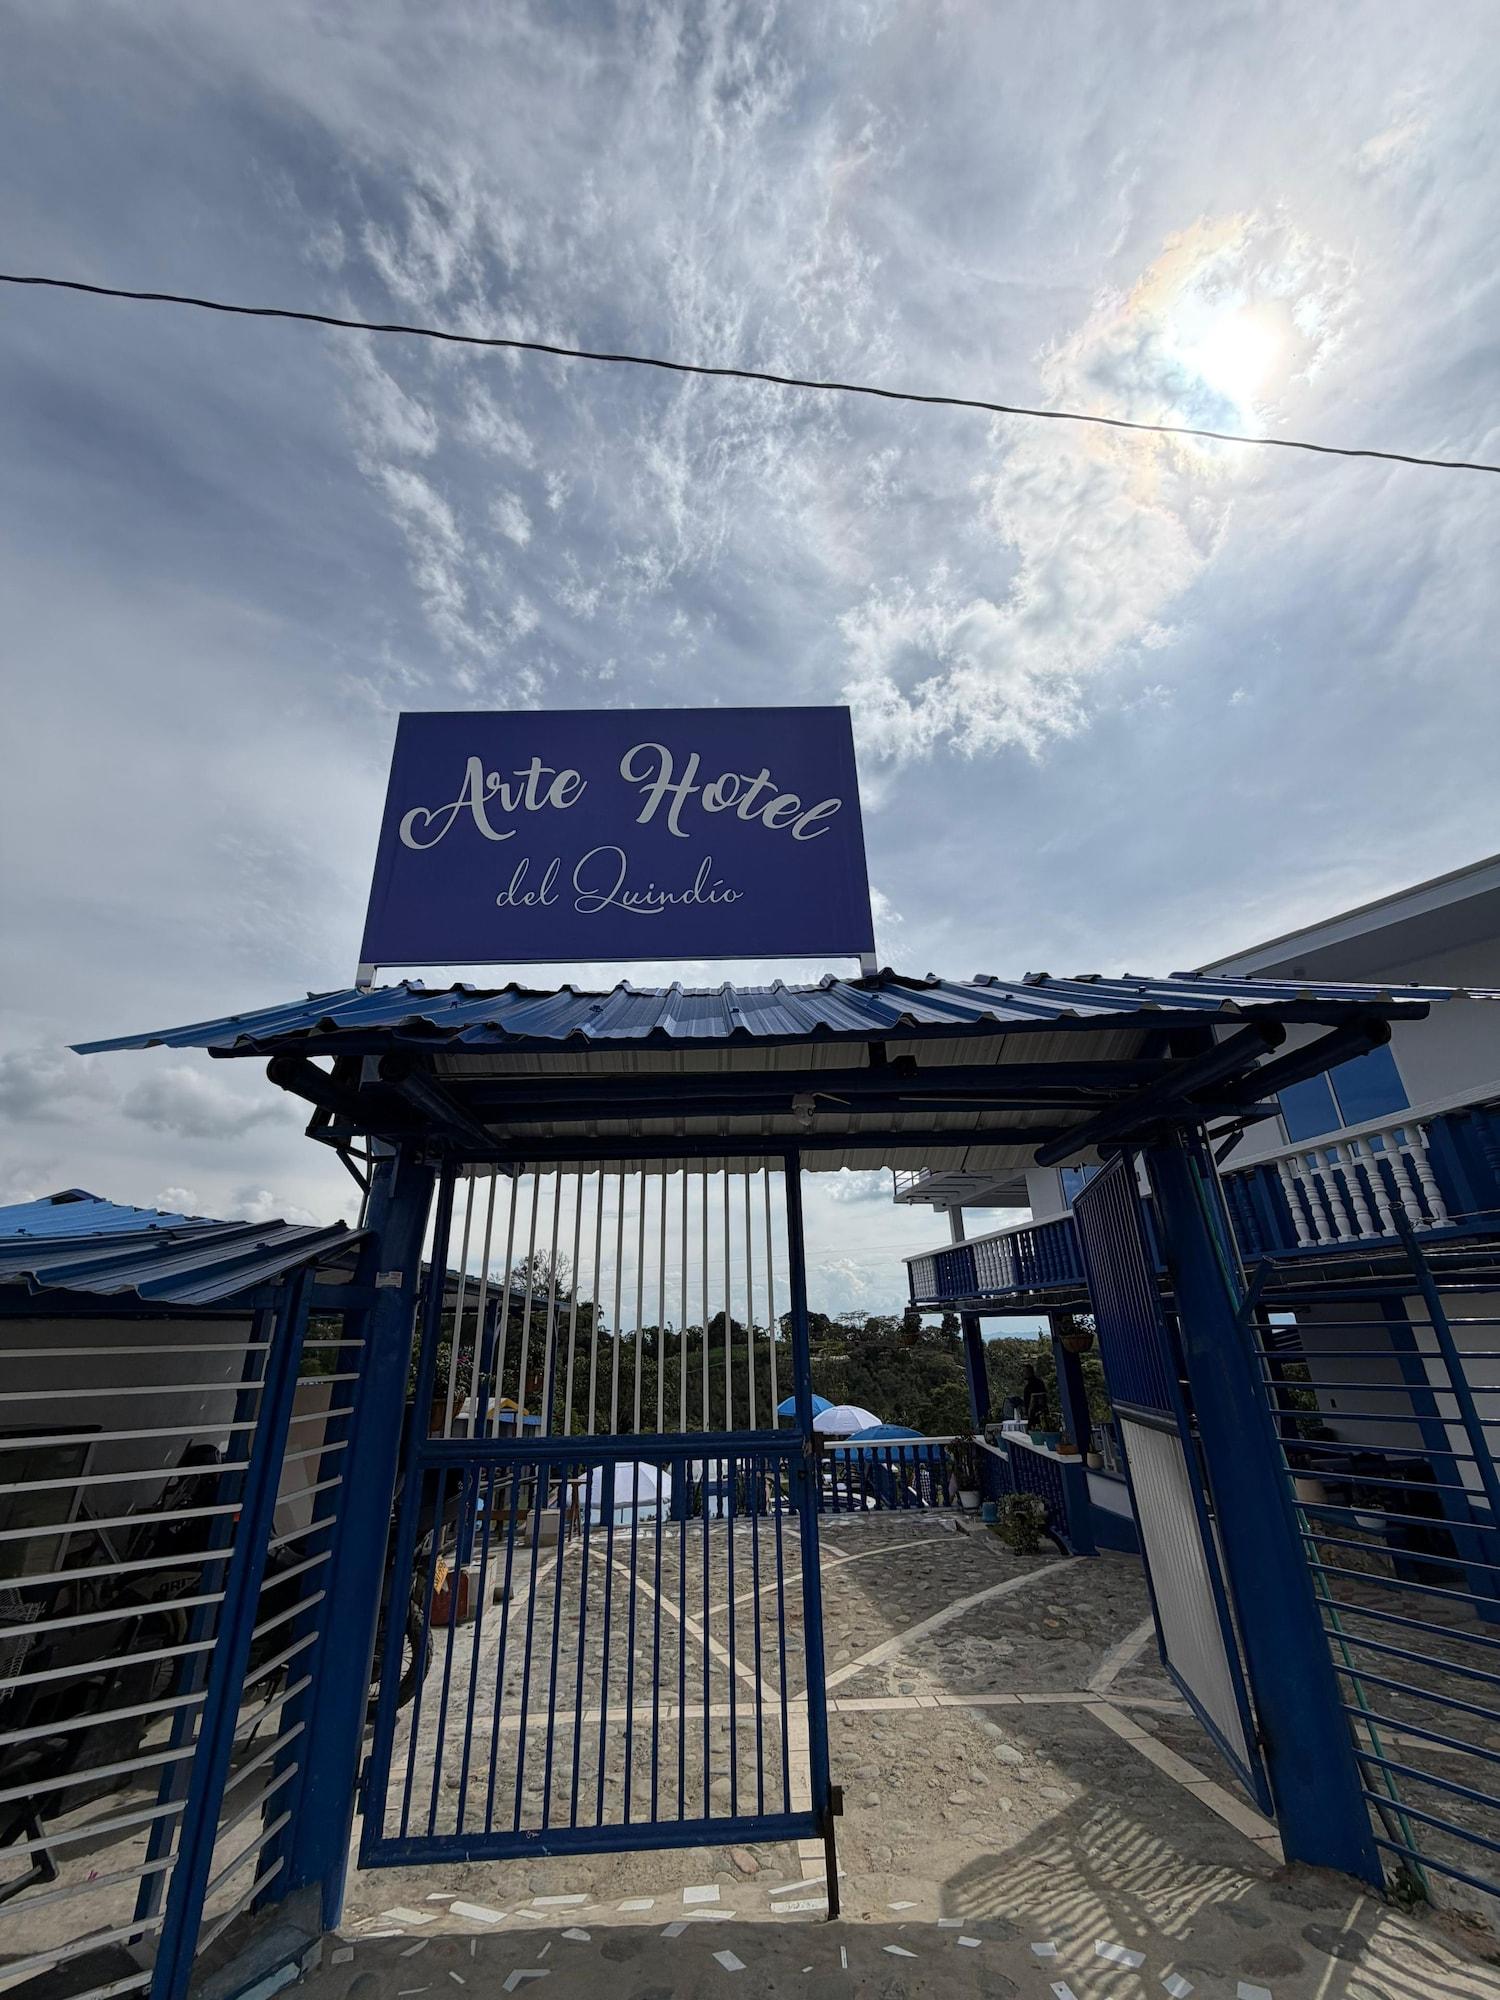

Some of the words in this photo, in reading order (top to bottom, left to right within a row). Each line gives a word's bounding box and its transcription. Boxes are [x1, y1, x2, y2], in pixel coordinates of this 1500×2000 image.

[399, 756, 588, 850] Arte
[620, 743, 842, 841] Hotel
[496, 857, 560, 907] del
[572, 845, 744, 914] Quindío
